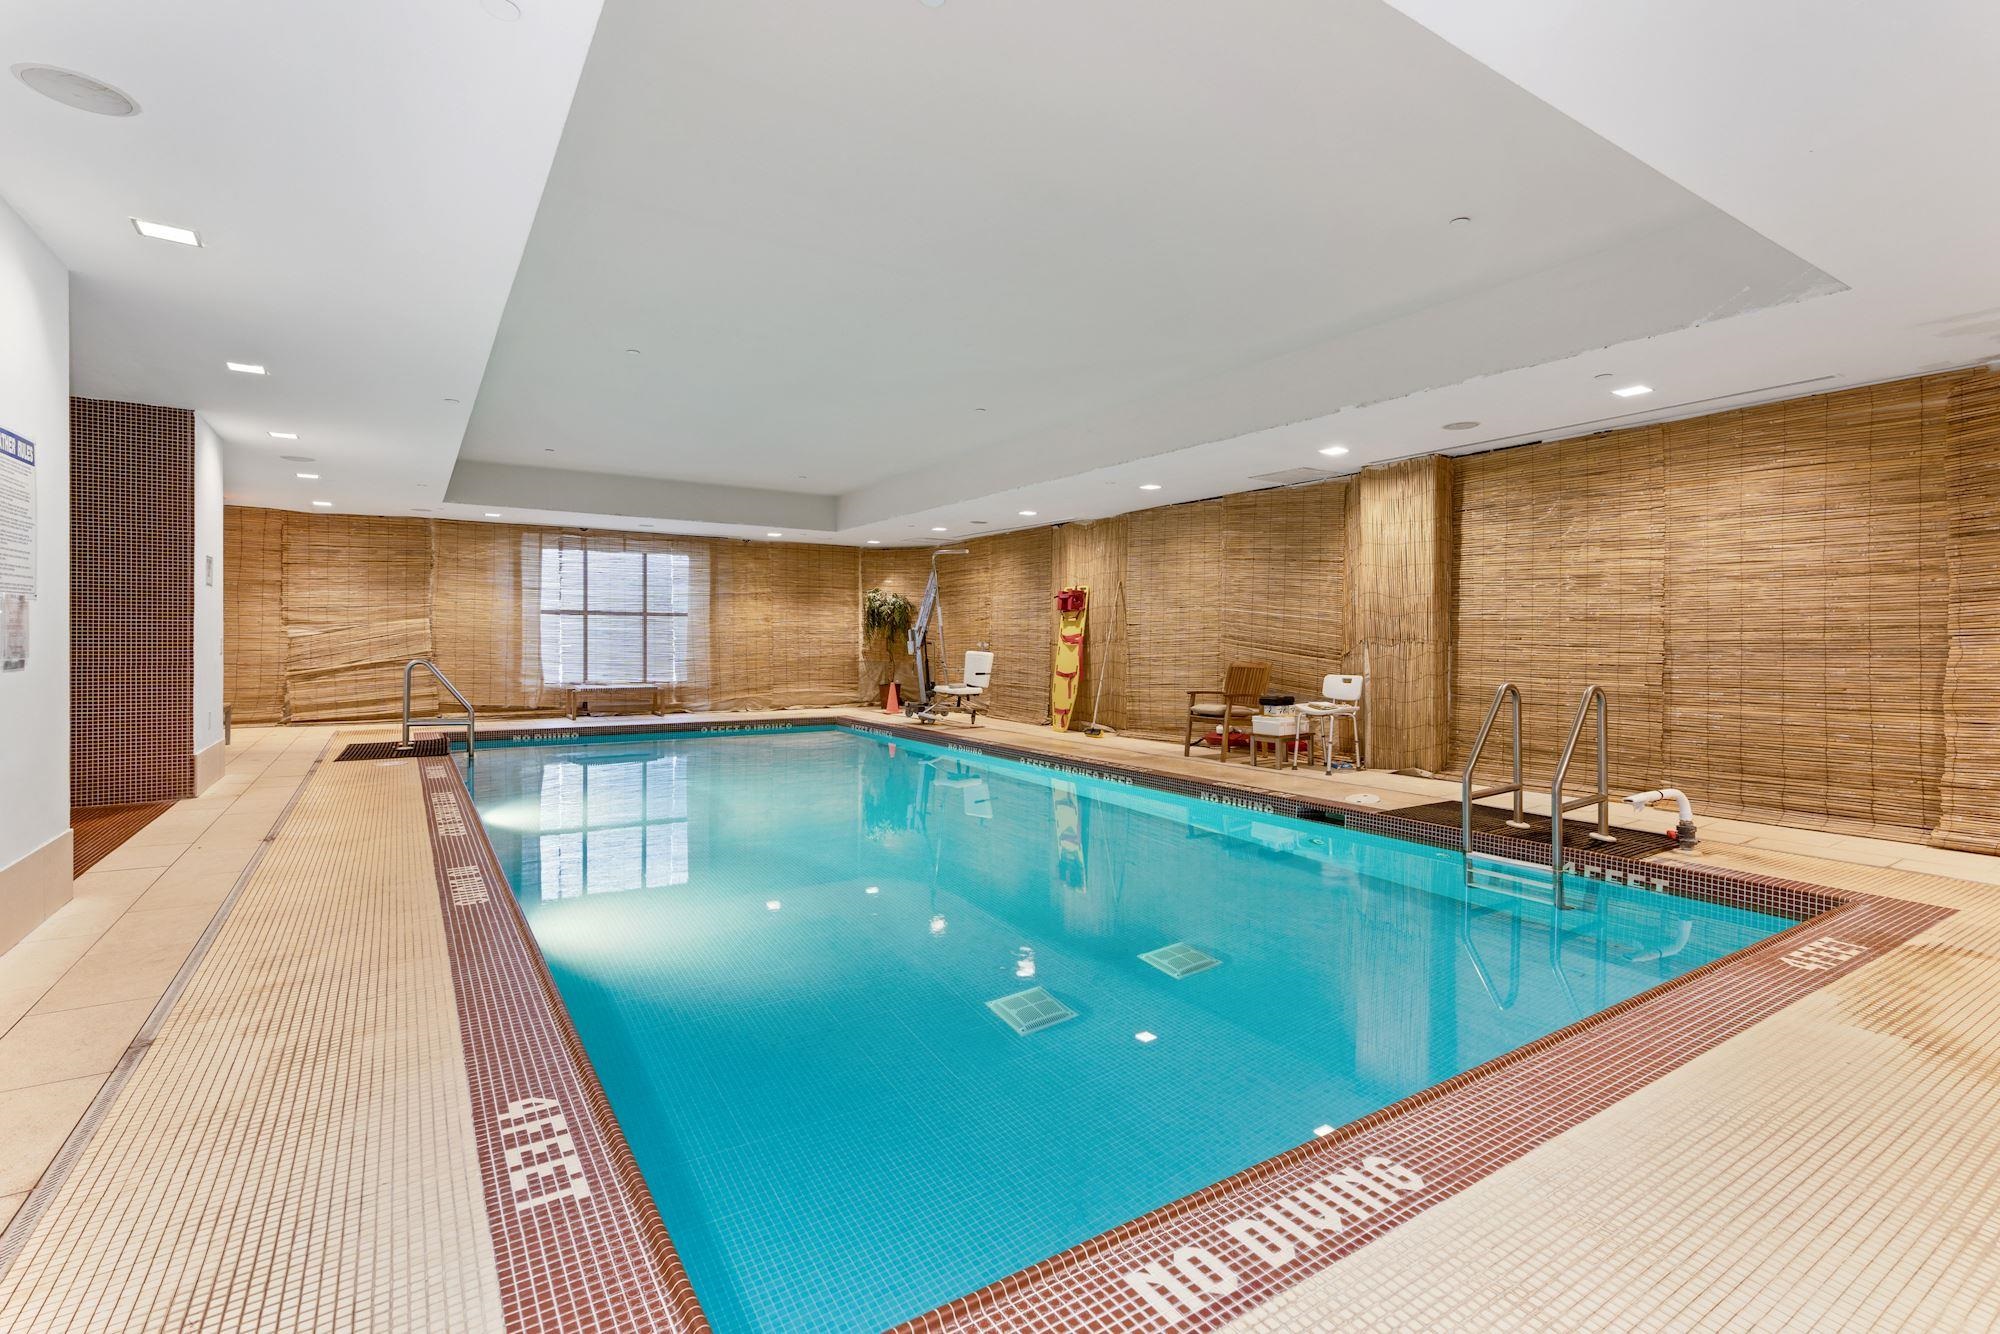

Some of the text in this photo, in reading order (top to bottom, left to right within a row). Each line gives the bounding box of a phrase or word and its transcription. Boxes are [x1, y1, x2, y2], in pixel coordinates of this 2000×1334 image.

[0, 432, 16, 454] THER
[502, 1115, 592, 1210] FEET
[1125, 1155, 1426, 1324] NO DIVING
